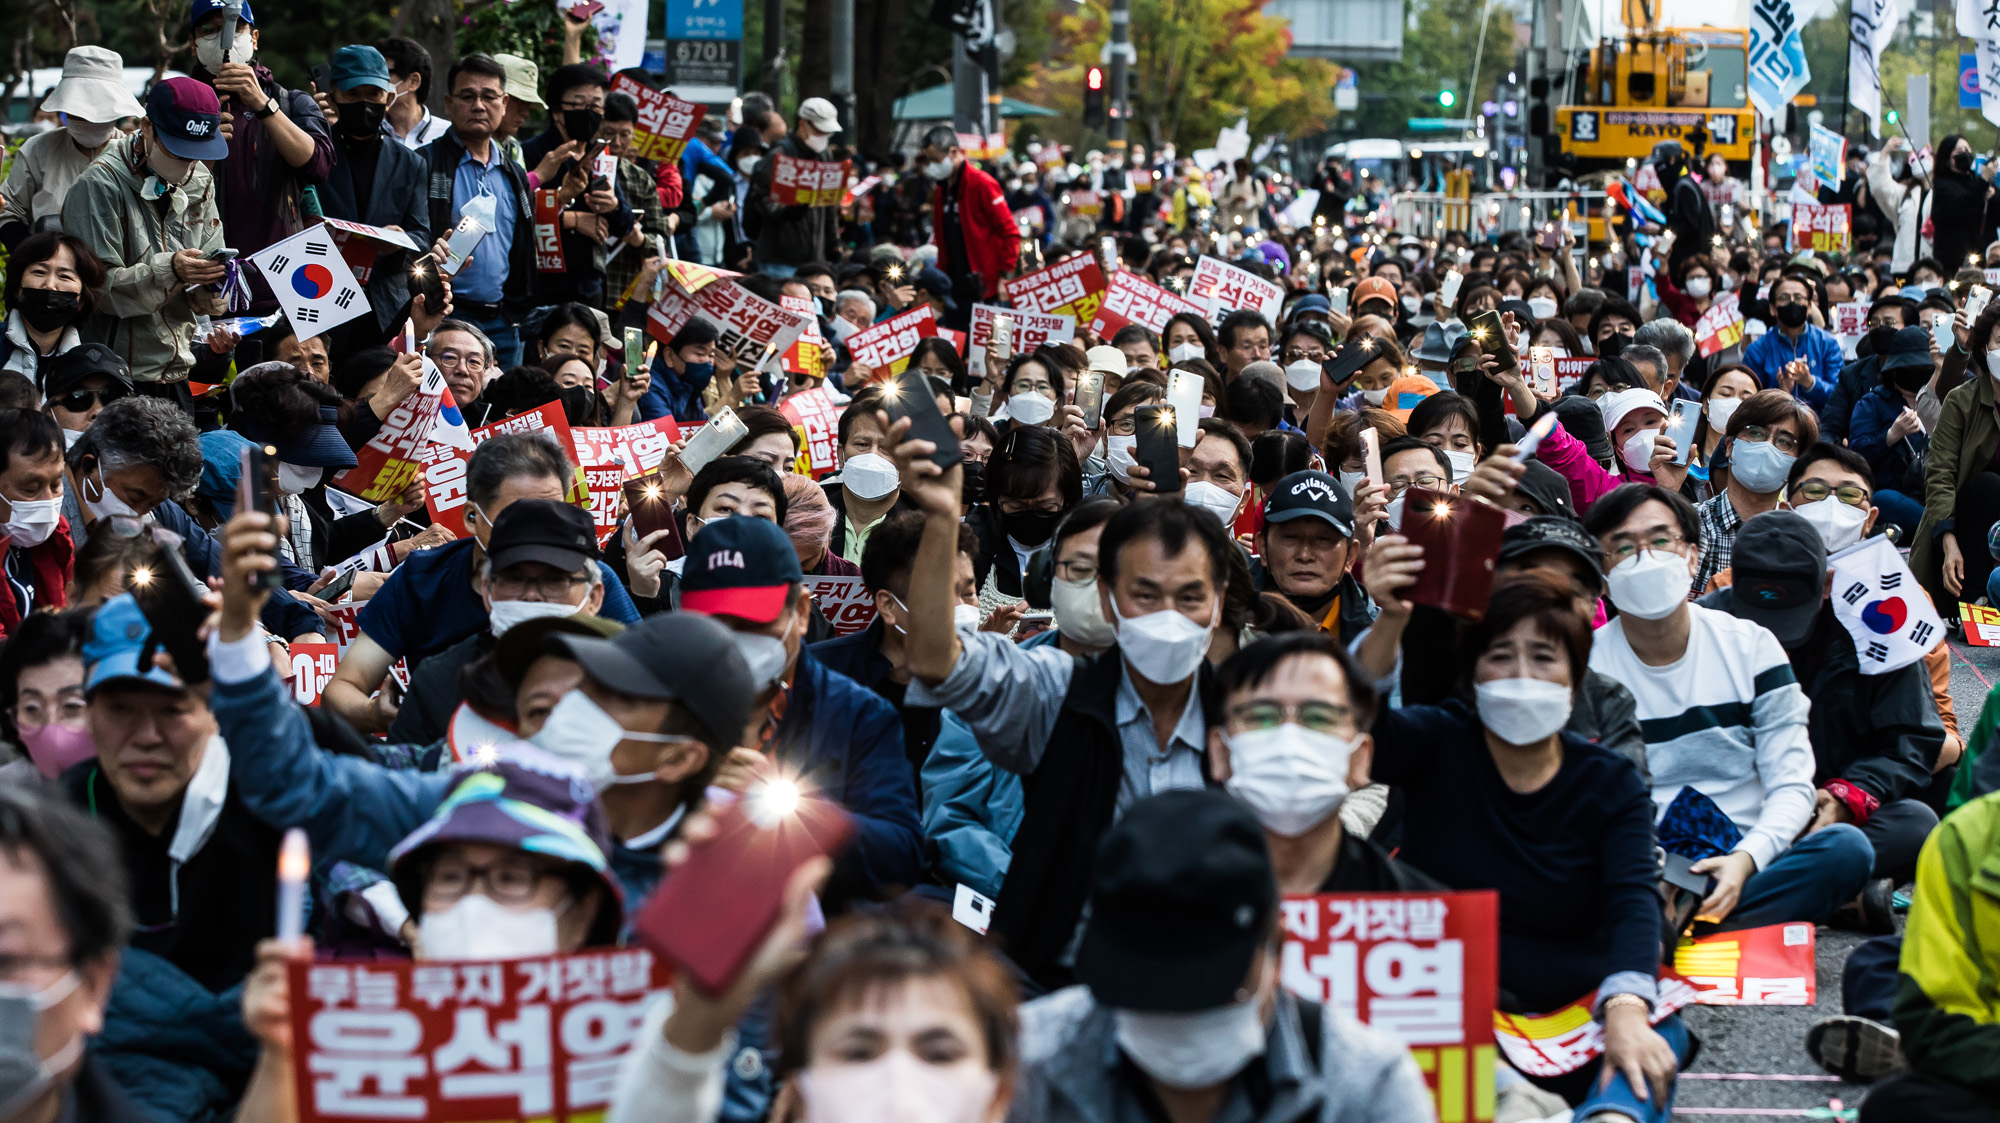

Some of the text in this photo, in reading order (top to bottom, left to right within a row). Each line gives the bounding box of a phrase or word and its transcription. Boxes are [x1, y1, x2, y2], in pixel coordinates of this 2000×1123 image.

[676, 42, 728, 63] 6701
[1628, 123, 1682, 138] KATO
[776, 163, 844, 191] 윤석열
[1007, 254, 1096, 295] 주가조작 허위경력
[1115, 271, 1161, 302] 주가조작
[701, 292, 782, 344] 윤석열
[743, 295, 769, 315] 무지
[847, 305, 933, 350] 주가조작 허위경력
[1027, 316, 1065, 331] 거짓말
[853, 327, 921, 370] 김건희
[586, 429, 613, 445] 무지
[614, 422, 658, 442] 거짓말
[1291, 477, 1338, 503] Callaway
[1329, 898, 1449, 941] 거짓말
[309, 949, 655, 1011] 무능 무지 거짓말
[308, 988, 676, 1119] 윤석열
